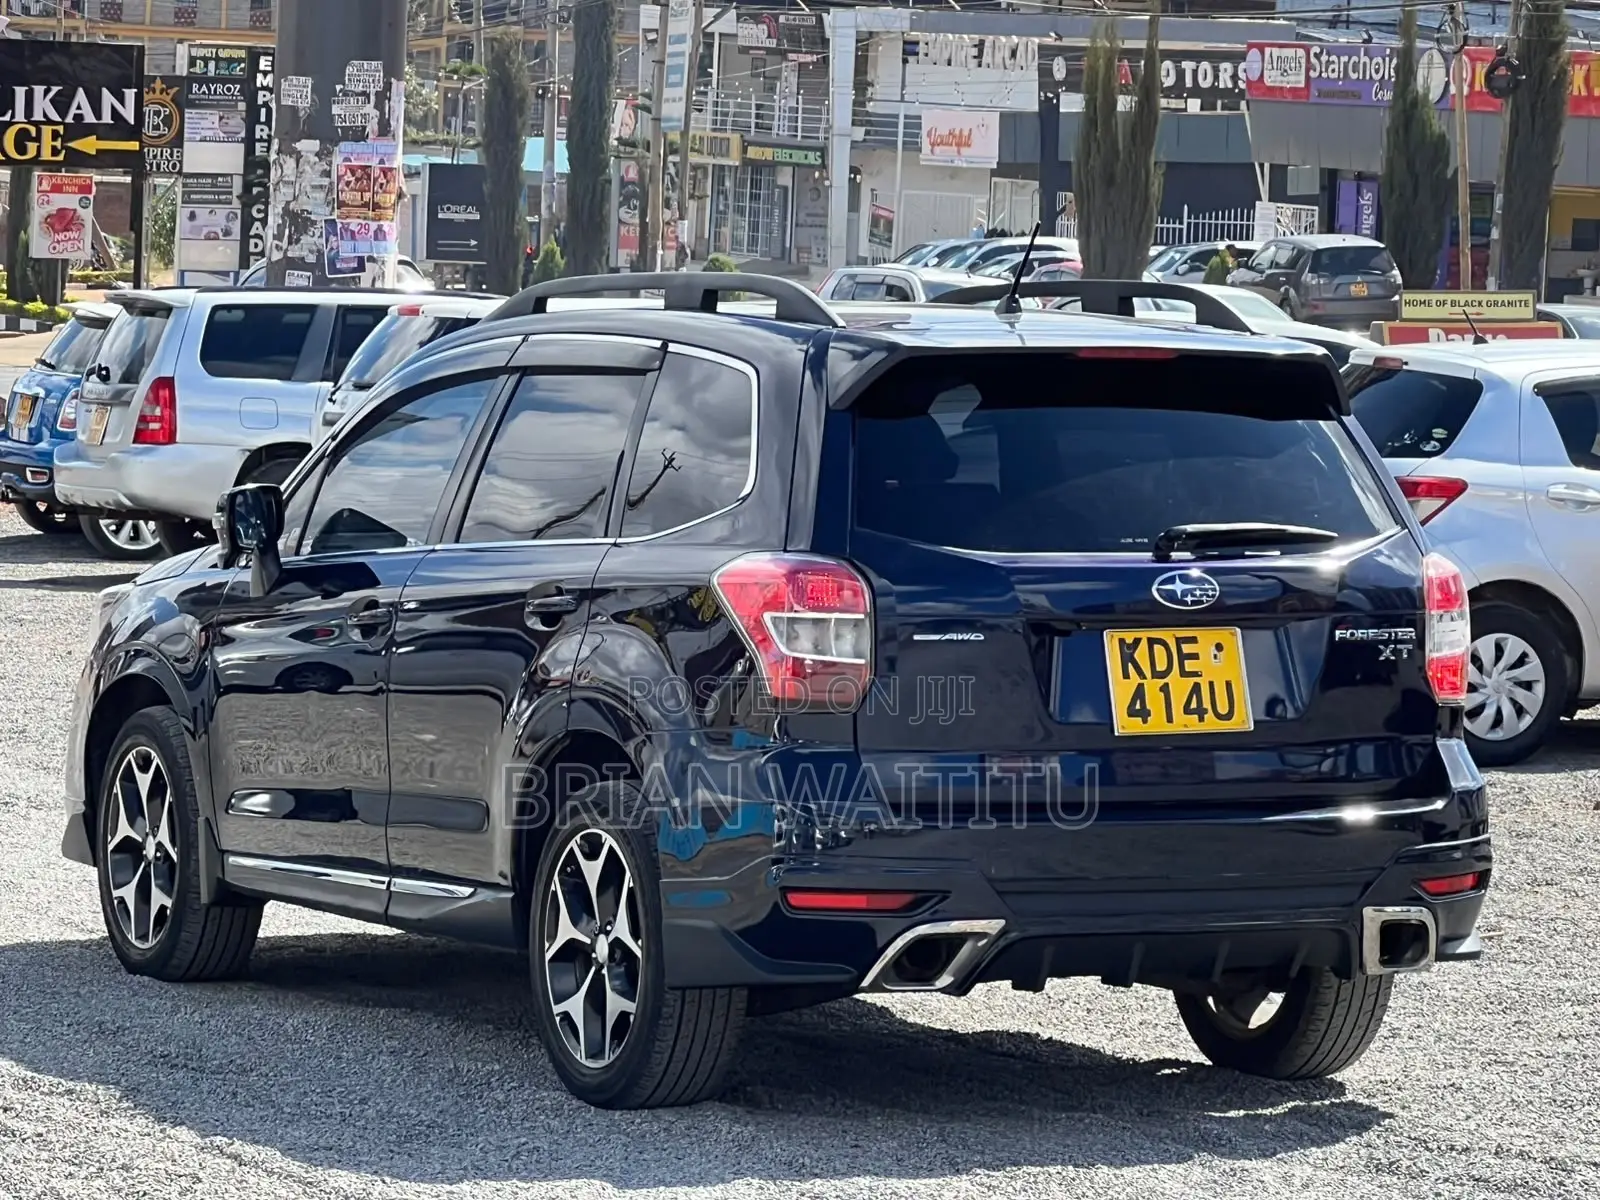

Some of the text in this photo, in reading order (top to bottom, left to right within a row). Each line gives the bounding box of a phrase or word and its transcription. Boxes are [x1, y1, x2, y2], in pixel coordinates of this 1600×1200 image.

[919, 35, 978, 68] EMPIRE
[1265, 49, 1303, 77] Angels
[192, 83, 241, 96] RAYROZ
[927, 127, 973, 156] Youthful
[53, 230, 81, 242] NOW
[356, 222, 370, 236] 29
[49, 239, 84, 255] OPEN
[1404, 299, 1530, 308] HOME OF BLACK GRANITE
[940, 632, 985, 640] AWD
[1335, 628, 1416, 641] FORESTER
[1118, 635, 1203, 680] KDE
[1378, 644, 1413, 660] XT
[1126, 680, 1235, 725] 414U
